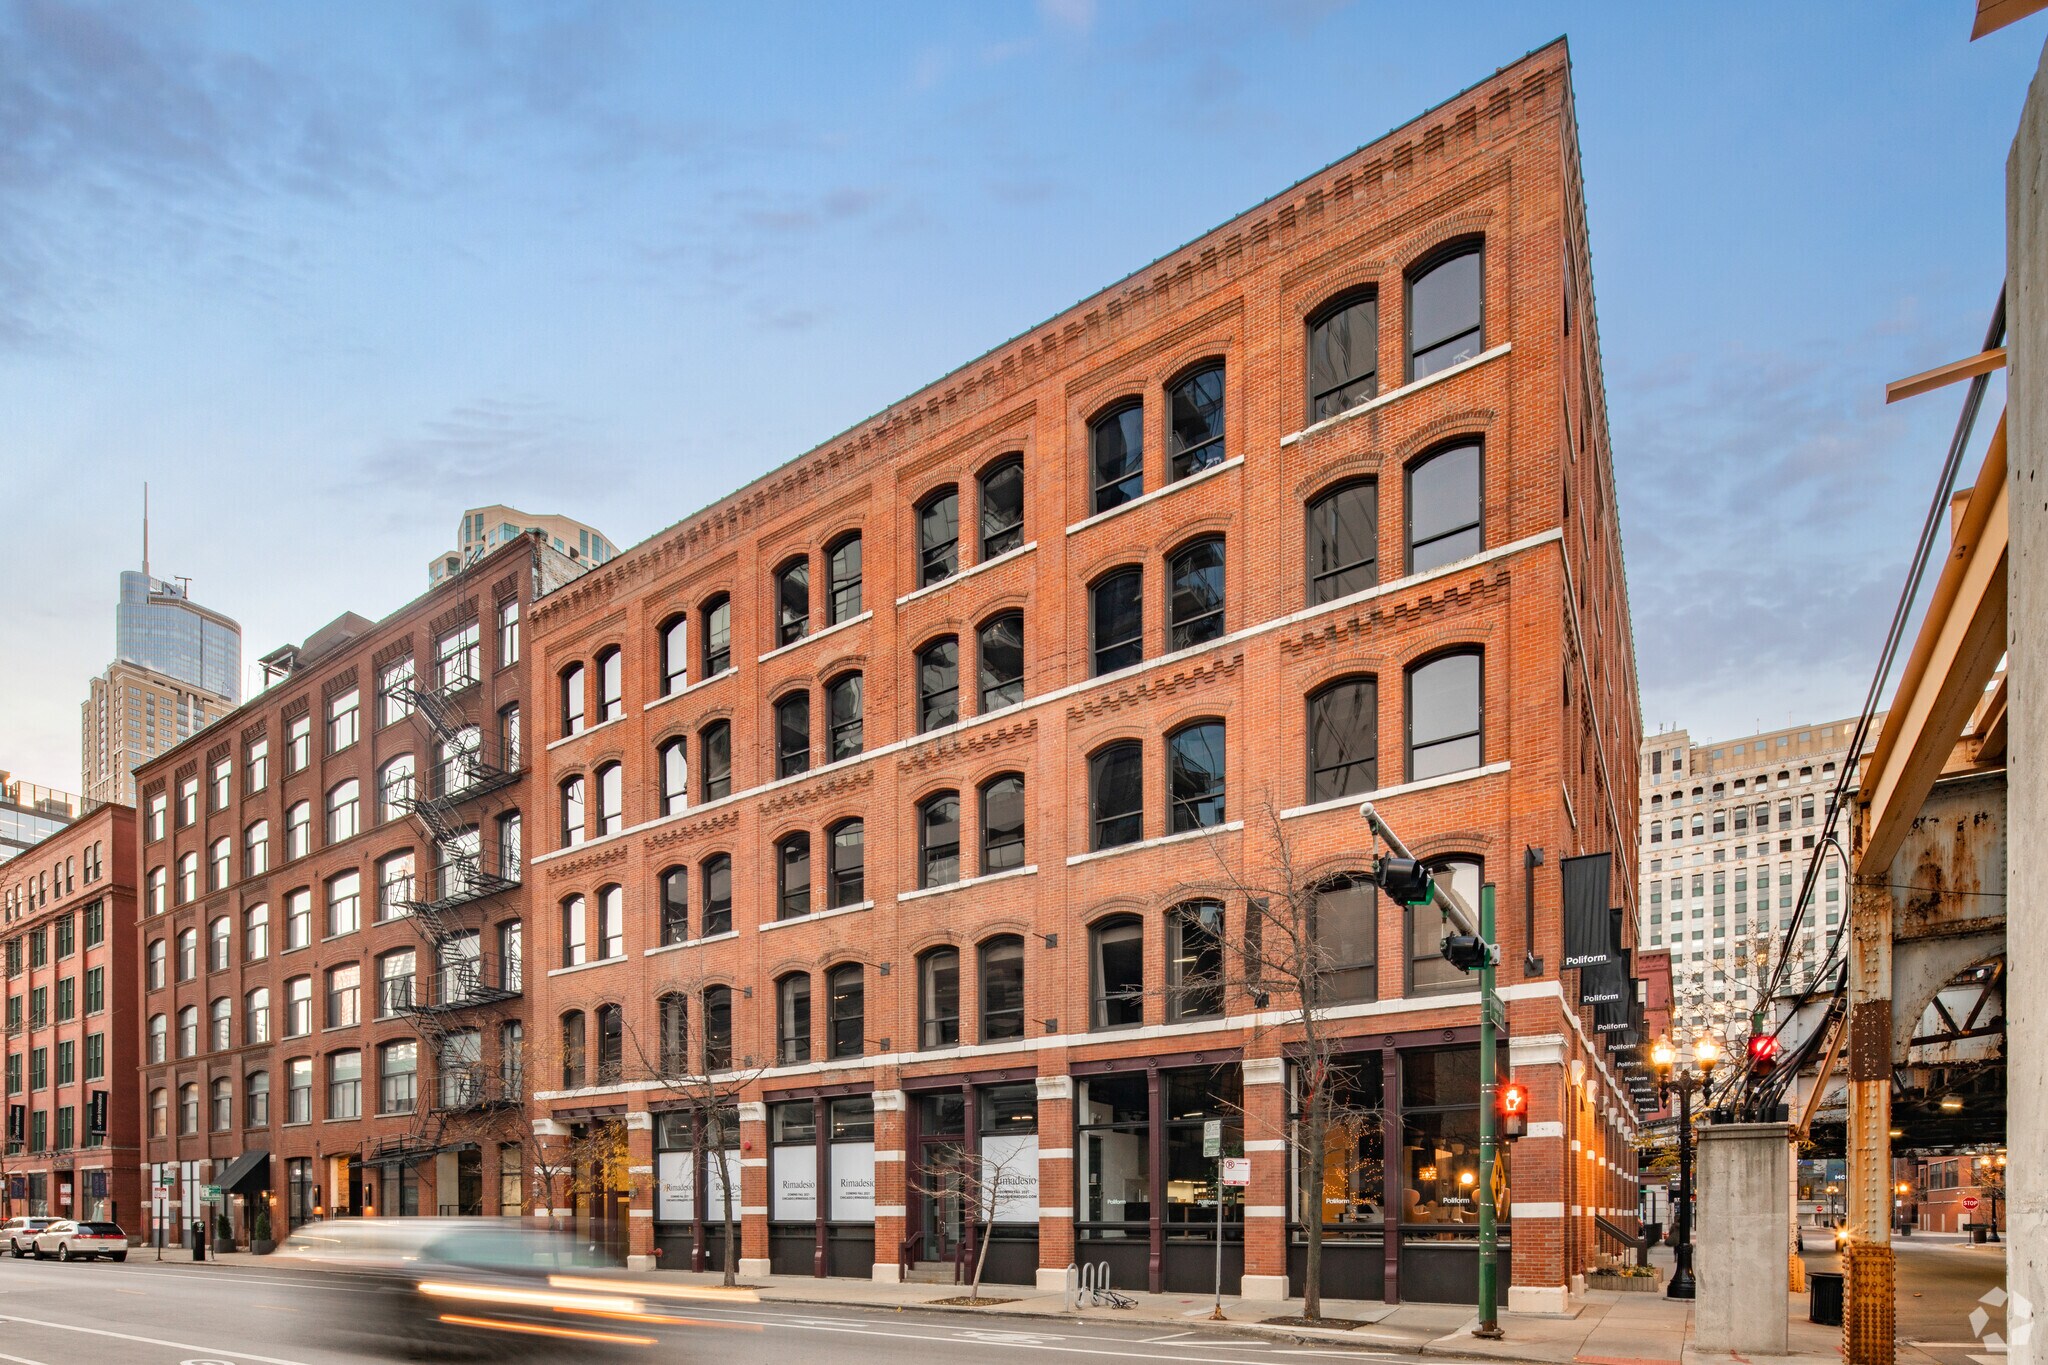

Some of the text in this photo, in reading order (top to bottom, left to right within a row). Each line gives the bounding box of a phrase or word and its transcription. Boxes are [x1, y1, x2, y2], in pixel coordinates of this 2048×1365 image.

[1566, 954, 1607, 966] Poliform
[1583, 993, 1619, 1003] Poliform
[1597, 1022, 1629, 1031] Poliform
[1608, 1043, 1636, 1051] Poliform
[782, 1180, 816, 1189] Rimadesio
